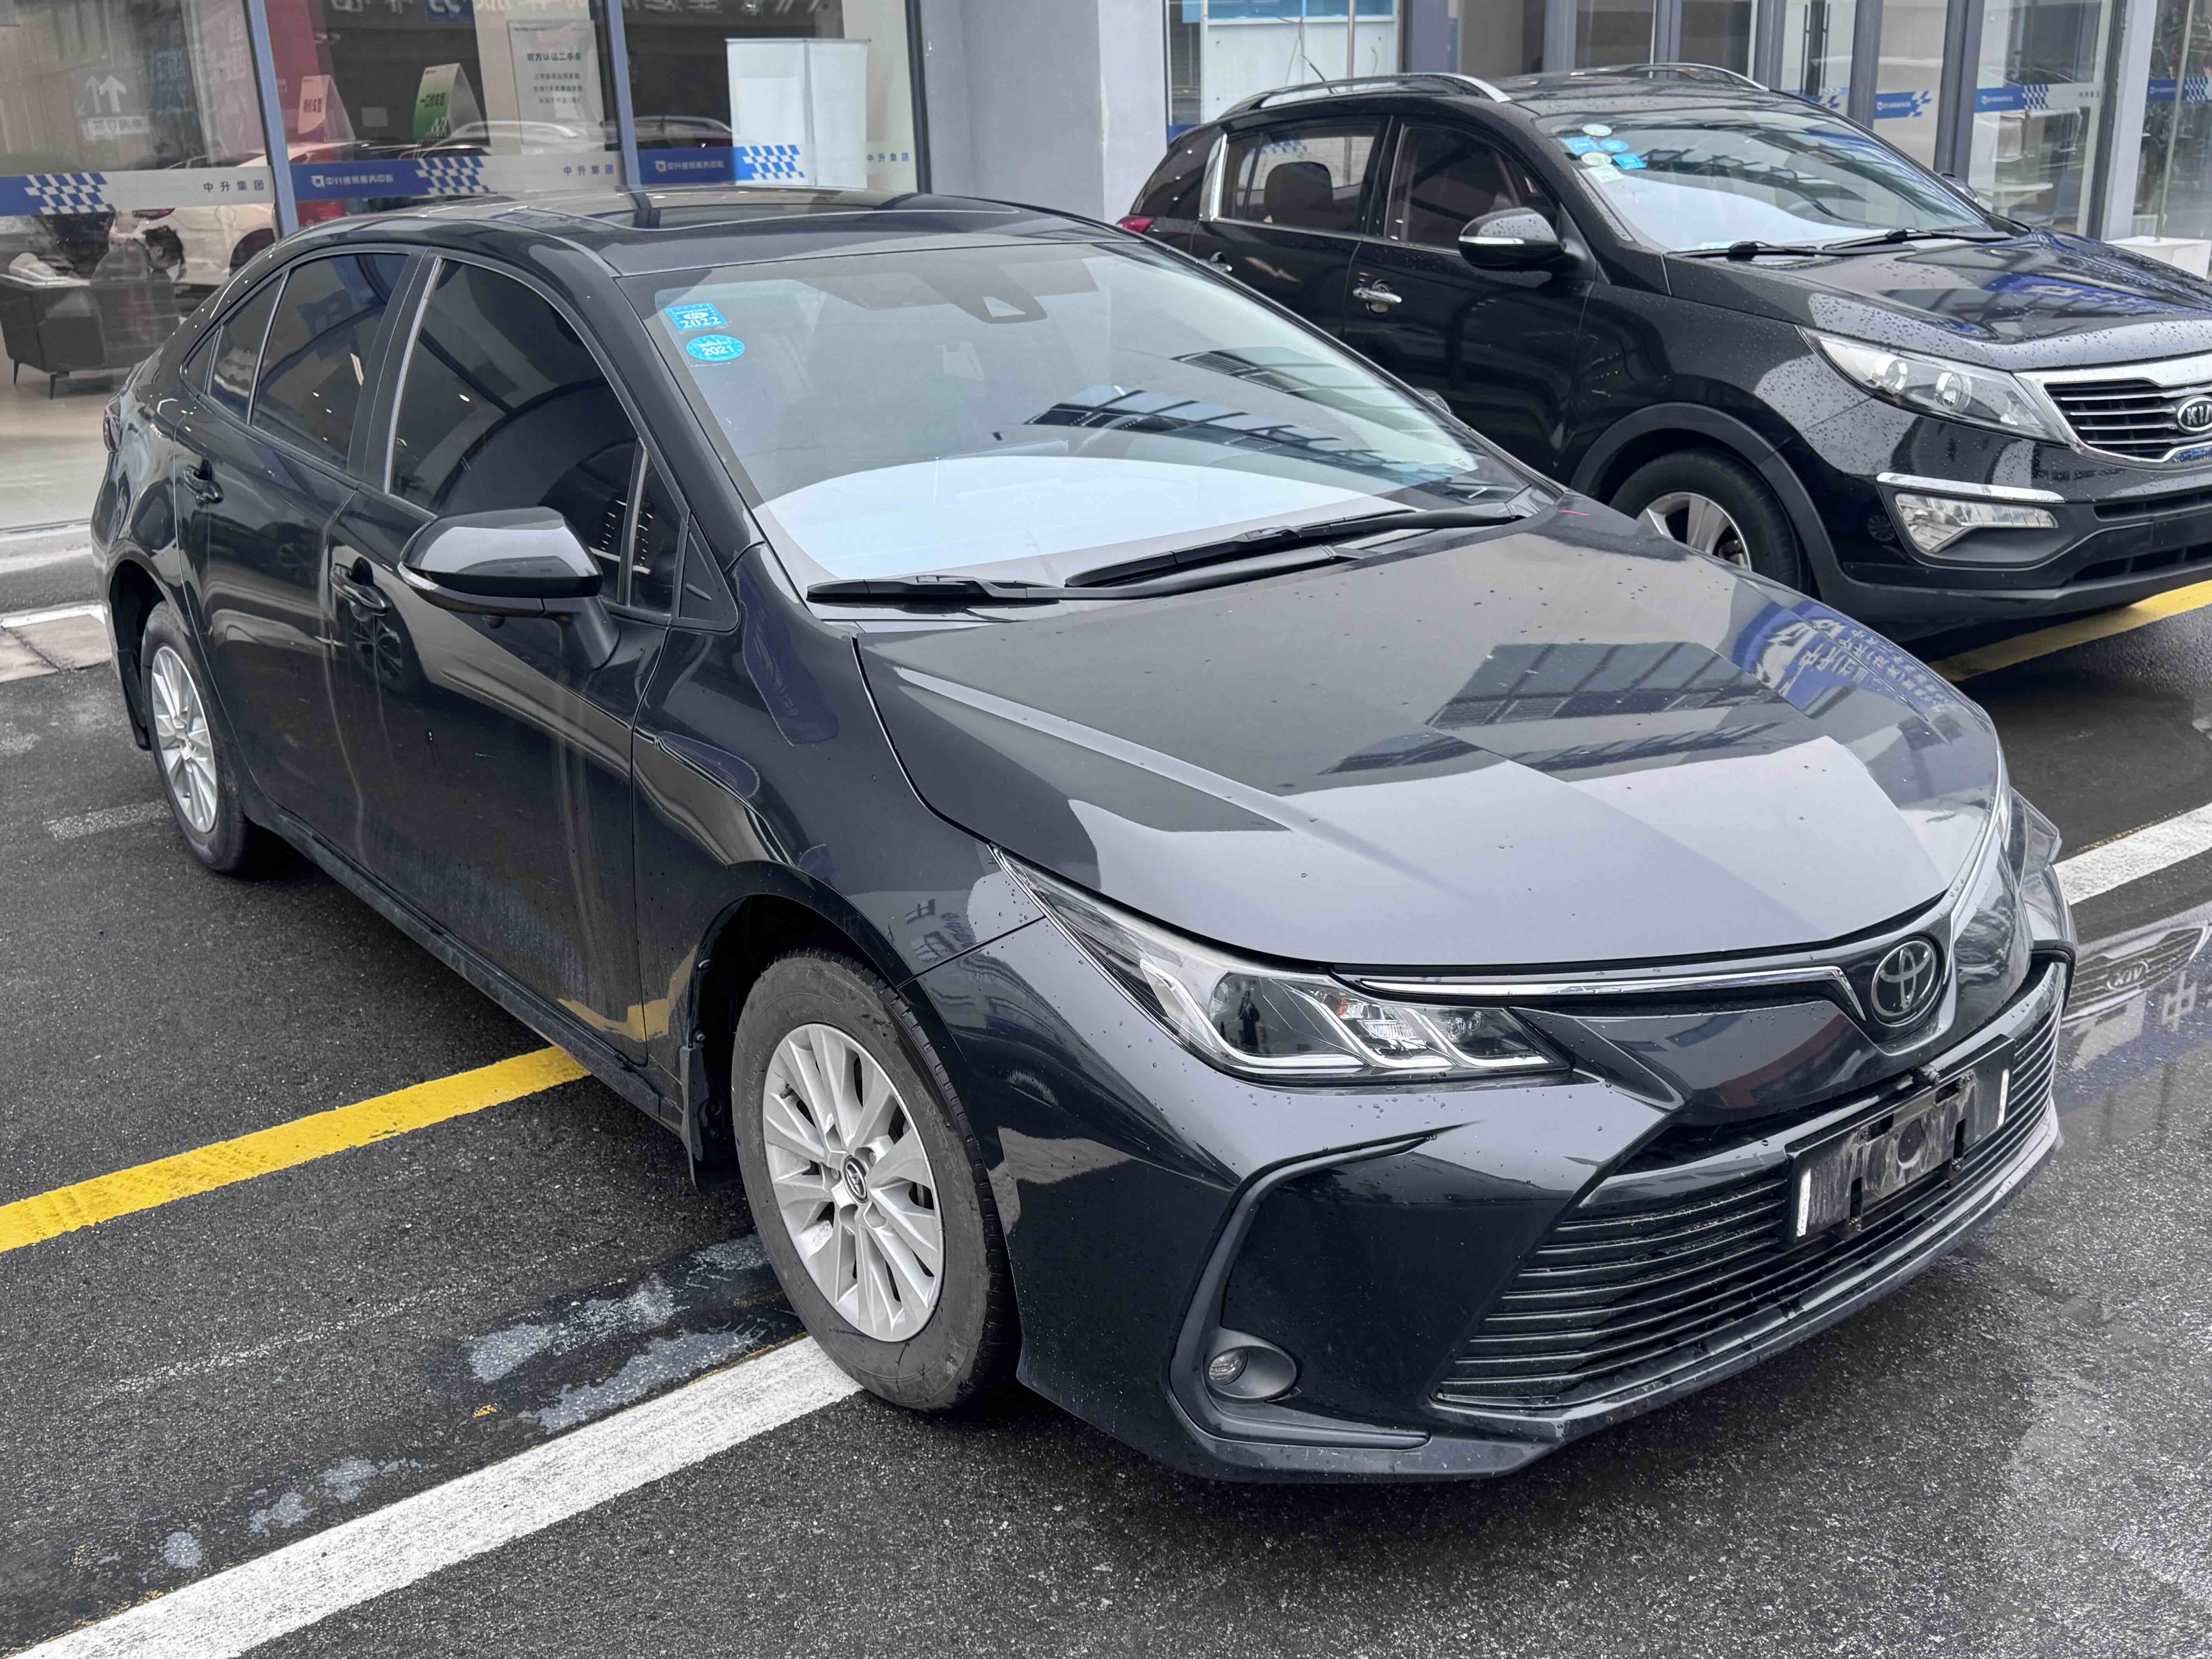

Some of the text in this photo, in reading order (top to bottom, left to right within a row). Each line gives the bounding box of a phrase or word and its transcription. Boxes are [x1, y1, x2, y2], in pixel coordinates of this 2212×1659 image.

[203, 180, 264, 192] 中升集团
[680, 316, 721, 328] 2022
[701, 344, 735, 356] 2021
